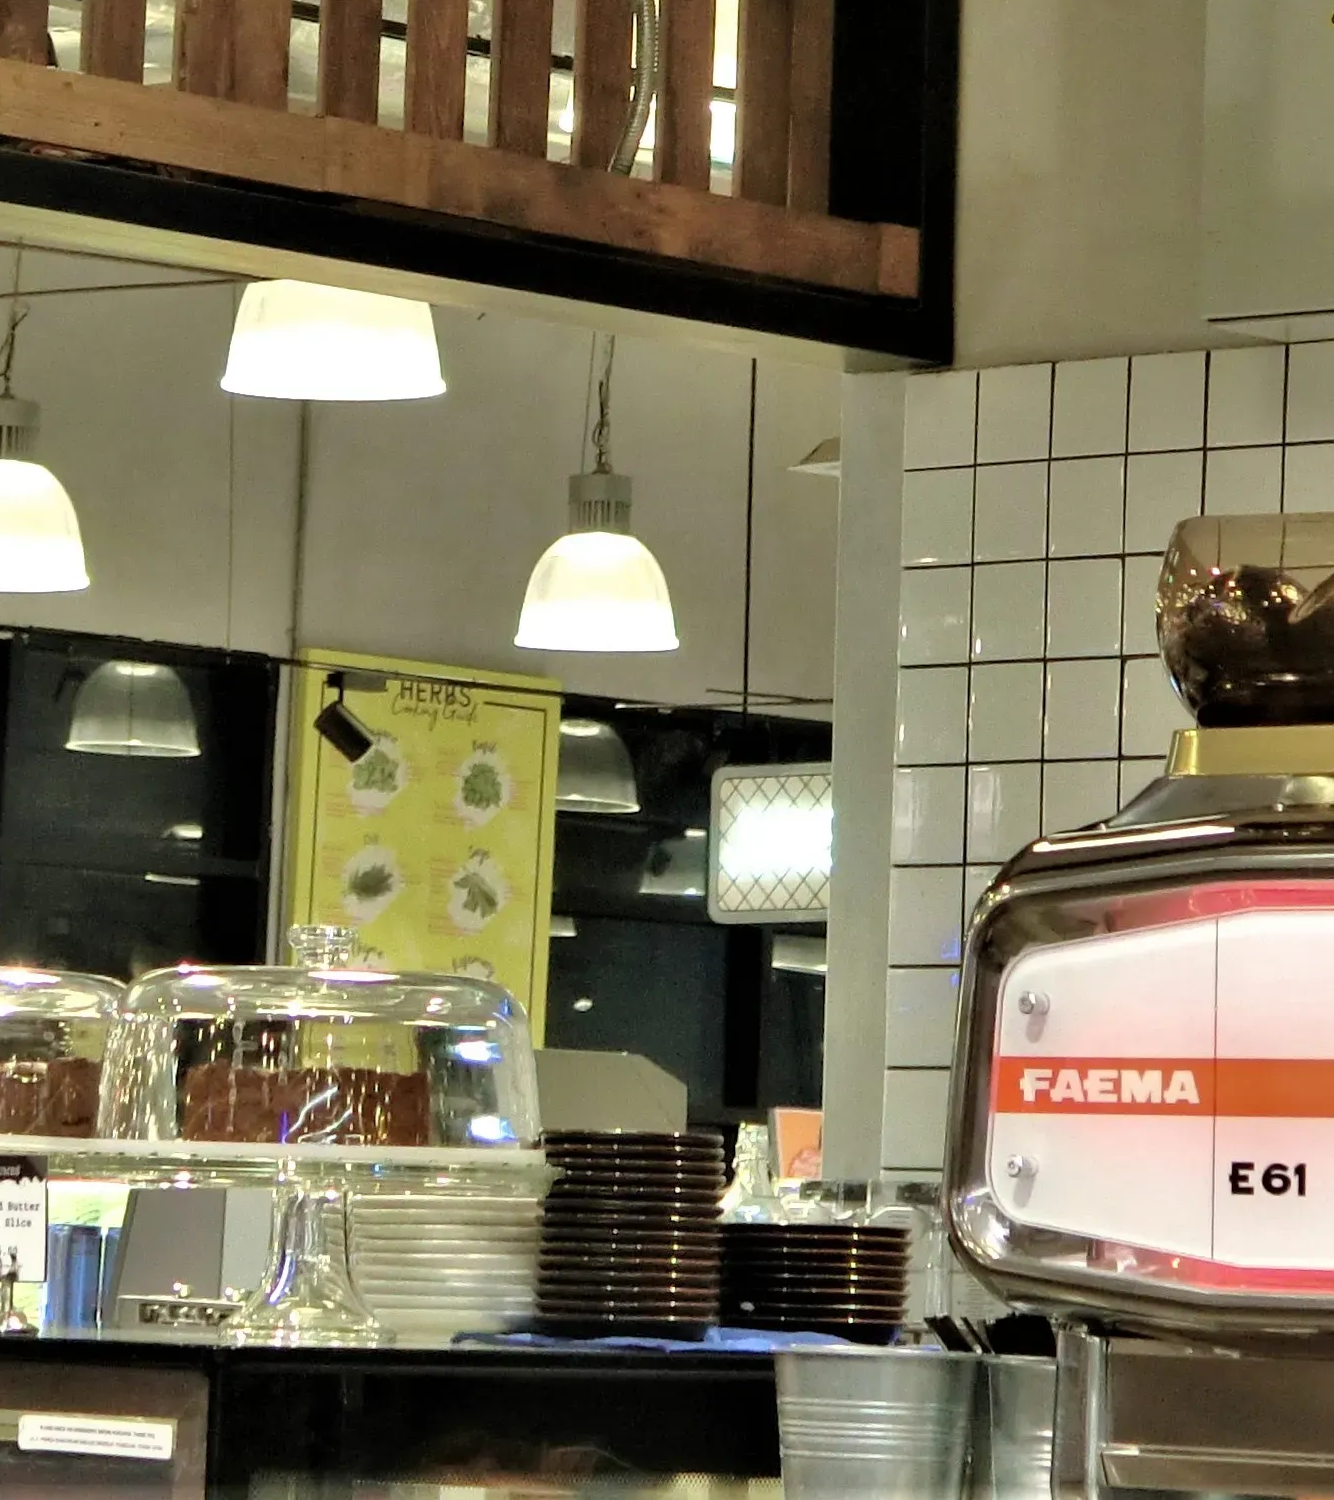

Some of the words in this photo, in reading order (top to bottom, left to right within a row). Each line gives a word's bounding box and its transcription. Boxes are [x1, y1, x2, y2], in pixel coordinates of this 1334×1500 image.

[399, 680, 472, 707] HERBS
[1019, 1068, 1200, 1106] FAEMA
[8, 1201, 40, 1212] Butter
[5, 1218, 32, 1228] Slice
